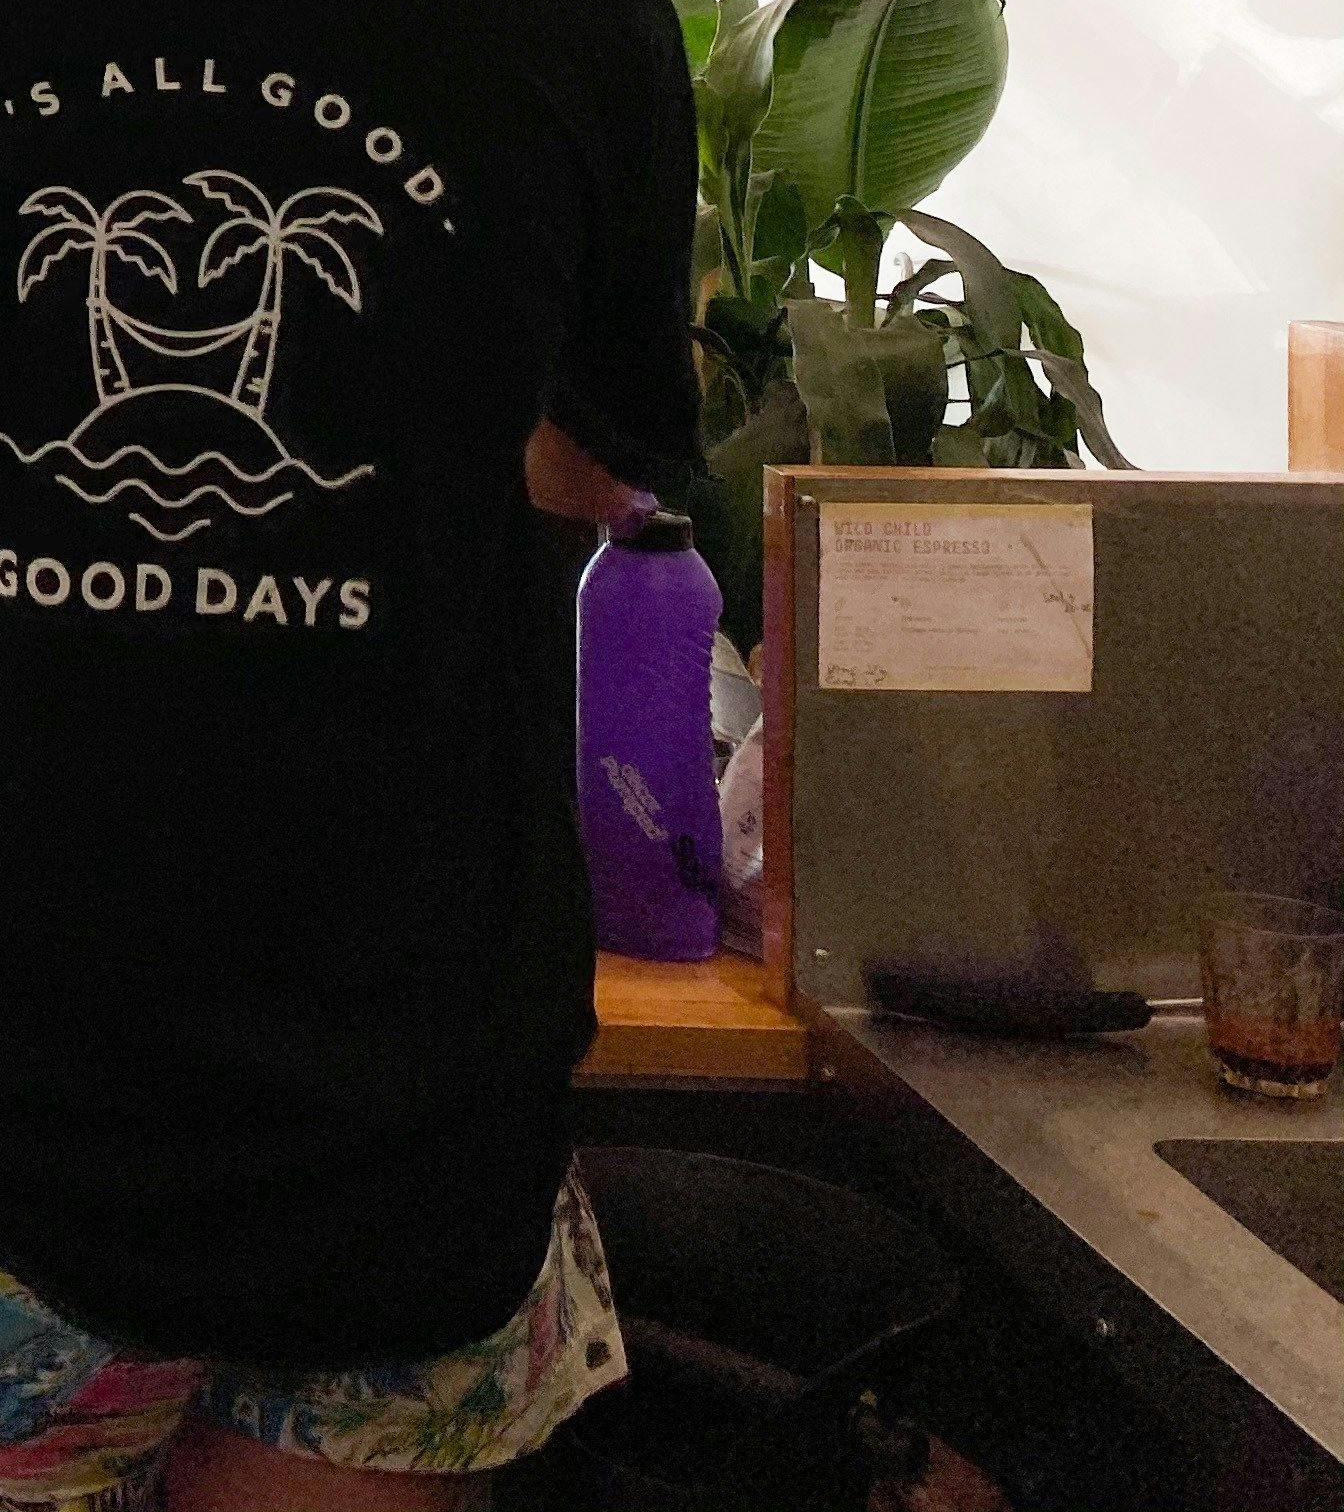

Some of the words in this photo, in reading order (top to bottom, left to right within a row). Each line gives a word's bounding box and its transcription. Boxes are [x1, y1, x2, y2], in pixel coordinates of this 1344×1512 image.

[101, 57, 226, 97] ALL
[261, 72, 444, 205] GOOD
[913, 539, 991, 555] ESPRESSO
[195, 568, 371, 629] DAYS
